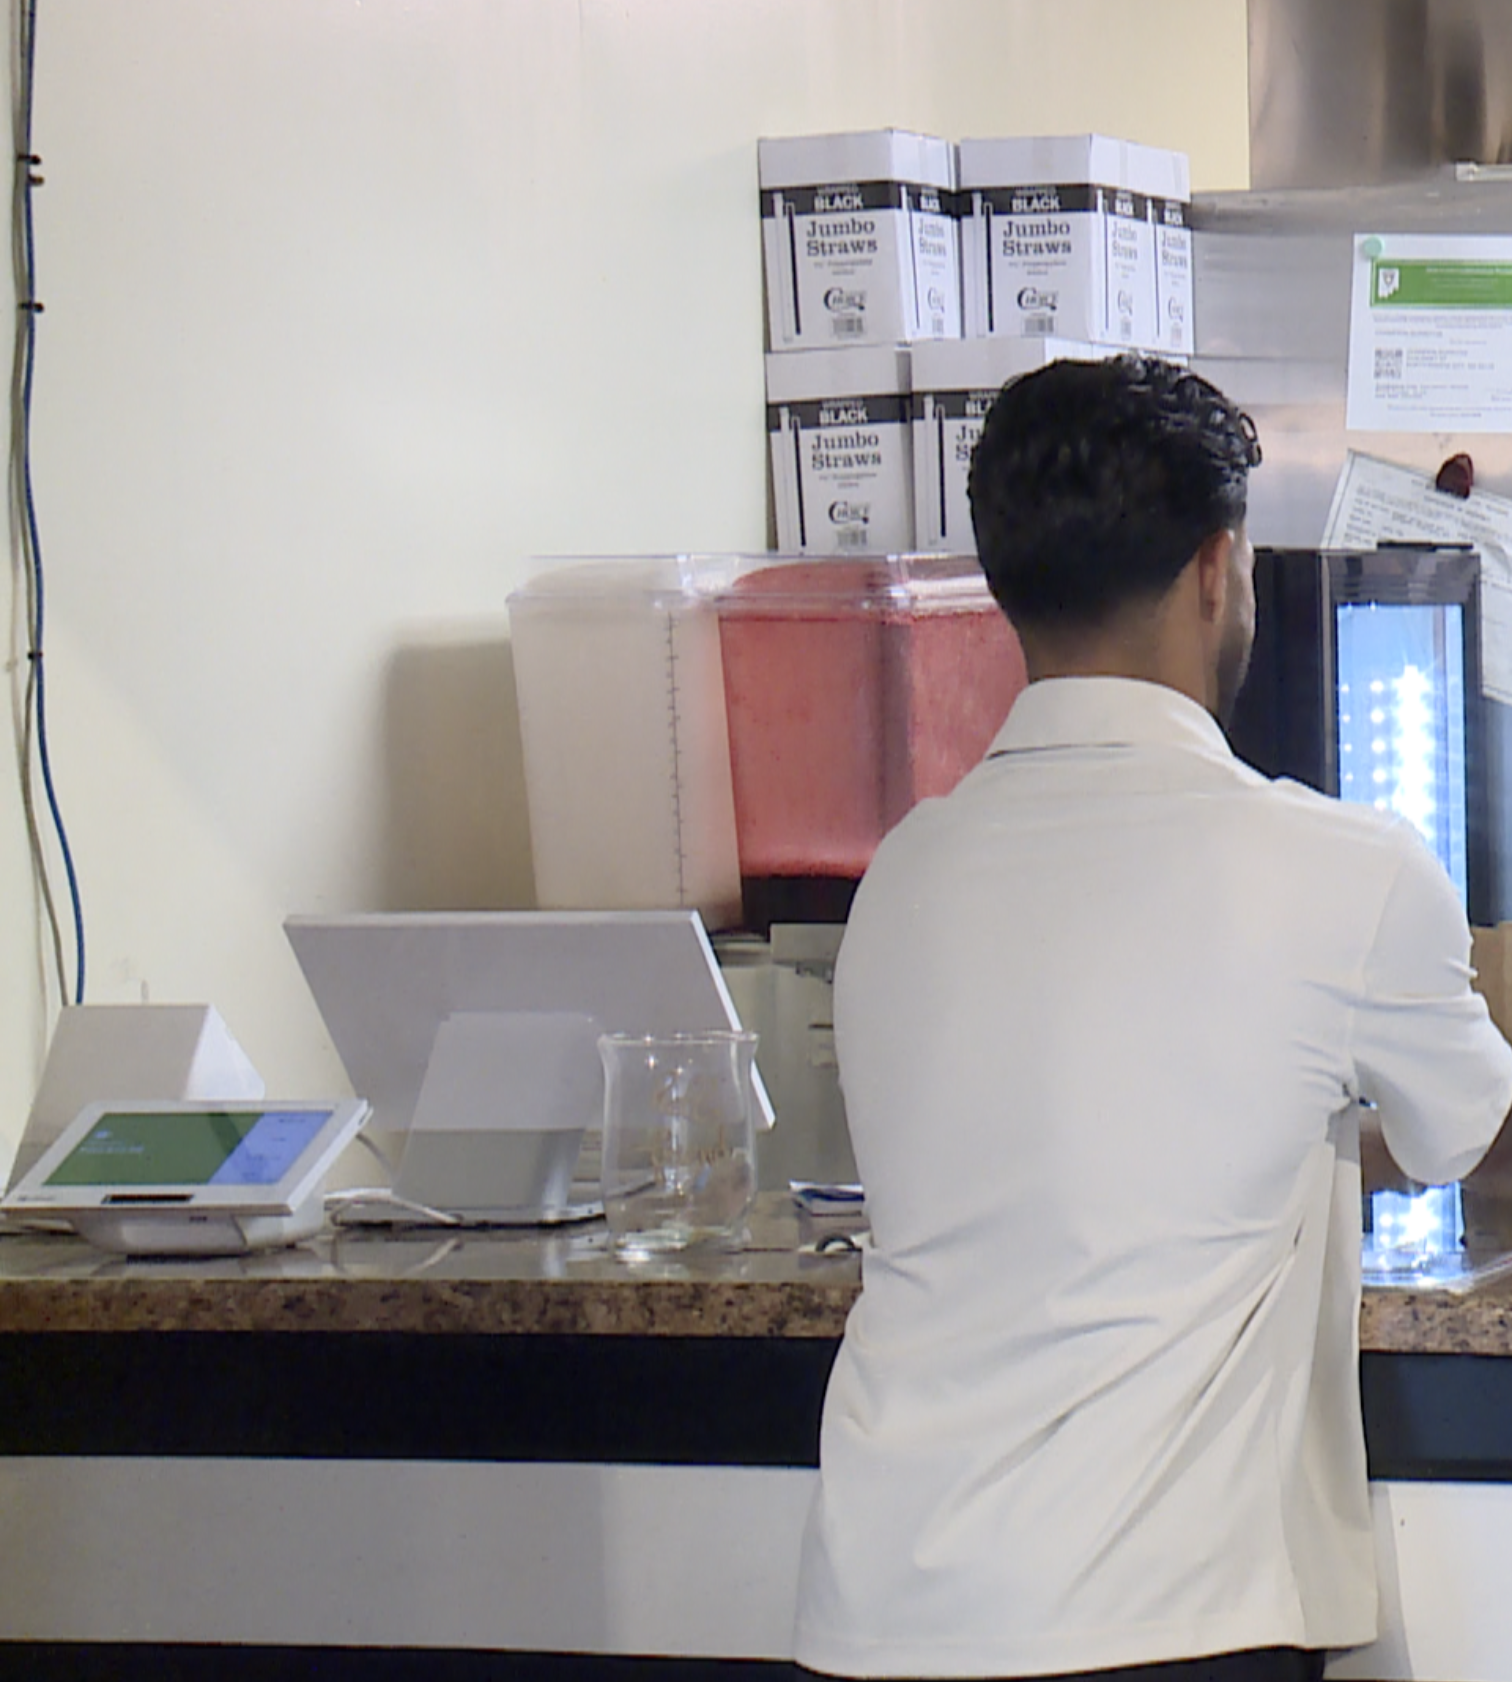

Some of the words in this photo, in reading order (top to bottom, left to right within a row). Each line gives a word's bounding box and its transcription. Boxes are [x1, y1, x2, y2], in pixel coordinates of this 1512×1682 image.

[814, 193, 864, 212] BLACK
[1012, 194, 1062, 212] BLACK
[806, 218, 876, 238] Jumbo
[1003, 218, 1071, 238] Jumbo
[806, 239, 878, 257] Straws
[1002, 239, 1072, 257] Straws
[819, 405, 869, 424] BLACK
[811, 431, 880, 451] Jumbo
[811, 451, 882, 471] Straws
